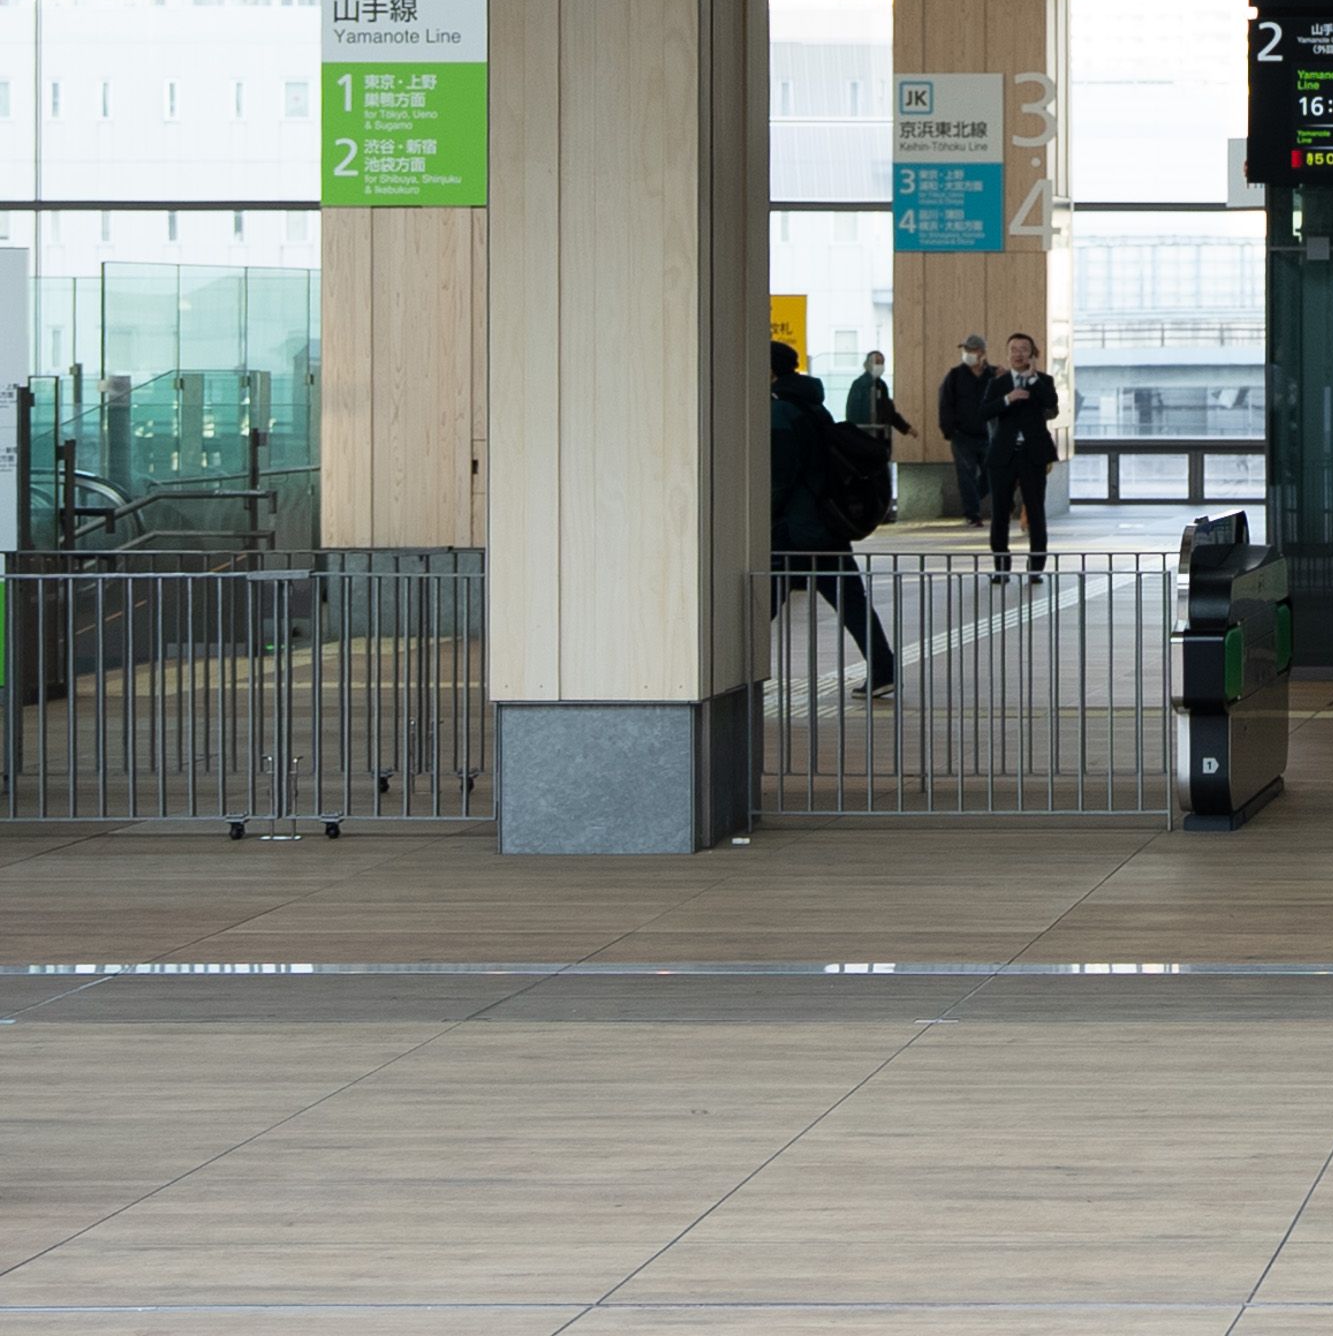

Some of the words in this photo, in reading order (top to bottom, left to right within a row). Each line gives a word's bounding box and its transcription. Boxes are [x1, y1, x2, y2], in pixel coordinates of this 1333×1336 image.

[334, 29, 420, 44] Yamanote
[426, 29, 462, 44] Line
[1257, 21, 1284, 62] 2
[337, 73, 353, 112] 1
[365, 74, 437, 90] 東京・上野
[1297, 81, 1320, 91] Line
[905, 90, 927, 106] JK
[1012, 72, 1058, 148] 3
[900, 121, 988, 139] 京浜東北線
[334, 137, 359, 177] 2
[968, 141, 988, 152] Line
[900, 169, 916, 194] 3
[899, 209, 917, 234] 4
[1009, 179, 1062, 251] 4
[1207, 761, 1212, 770] 1
